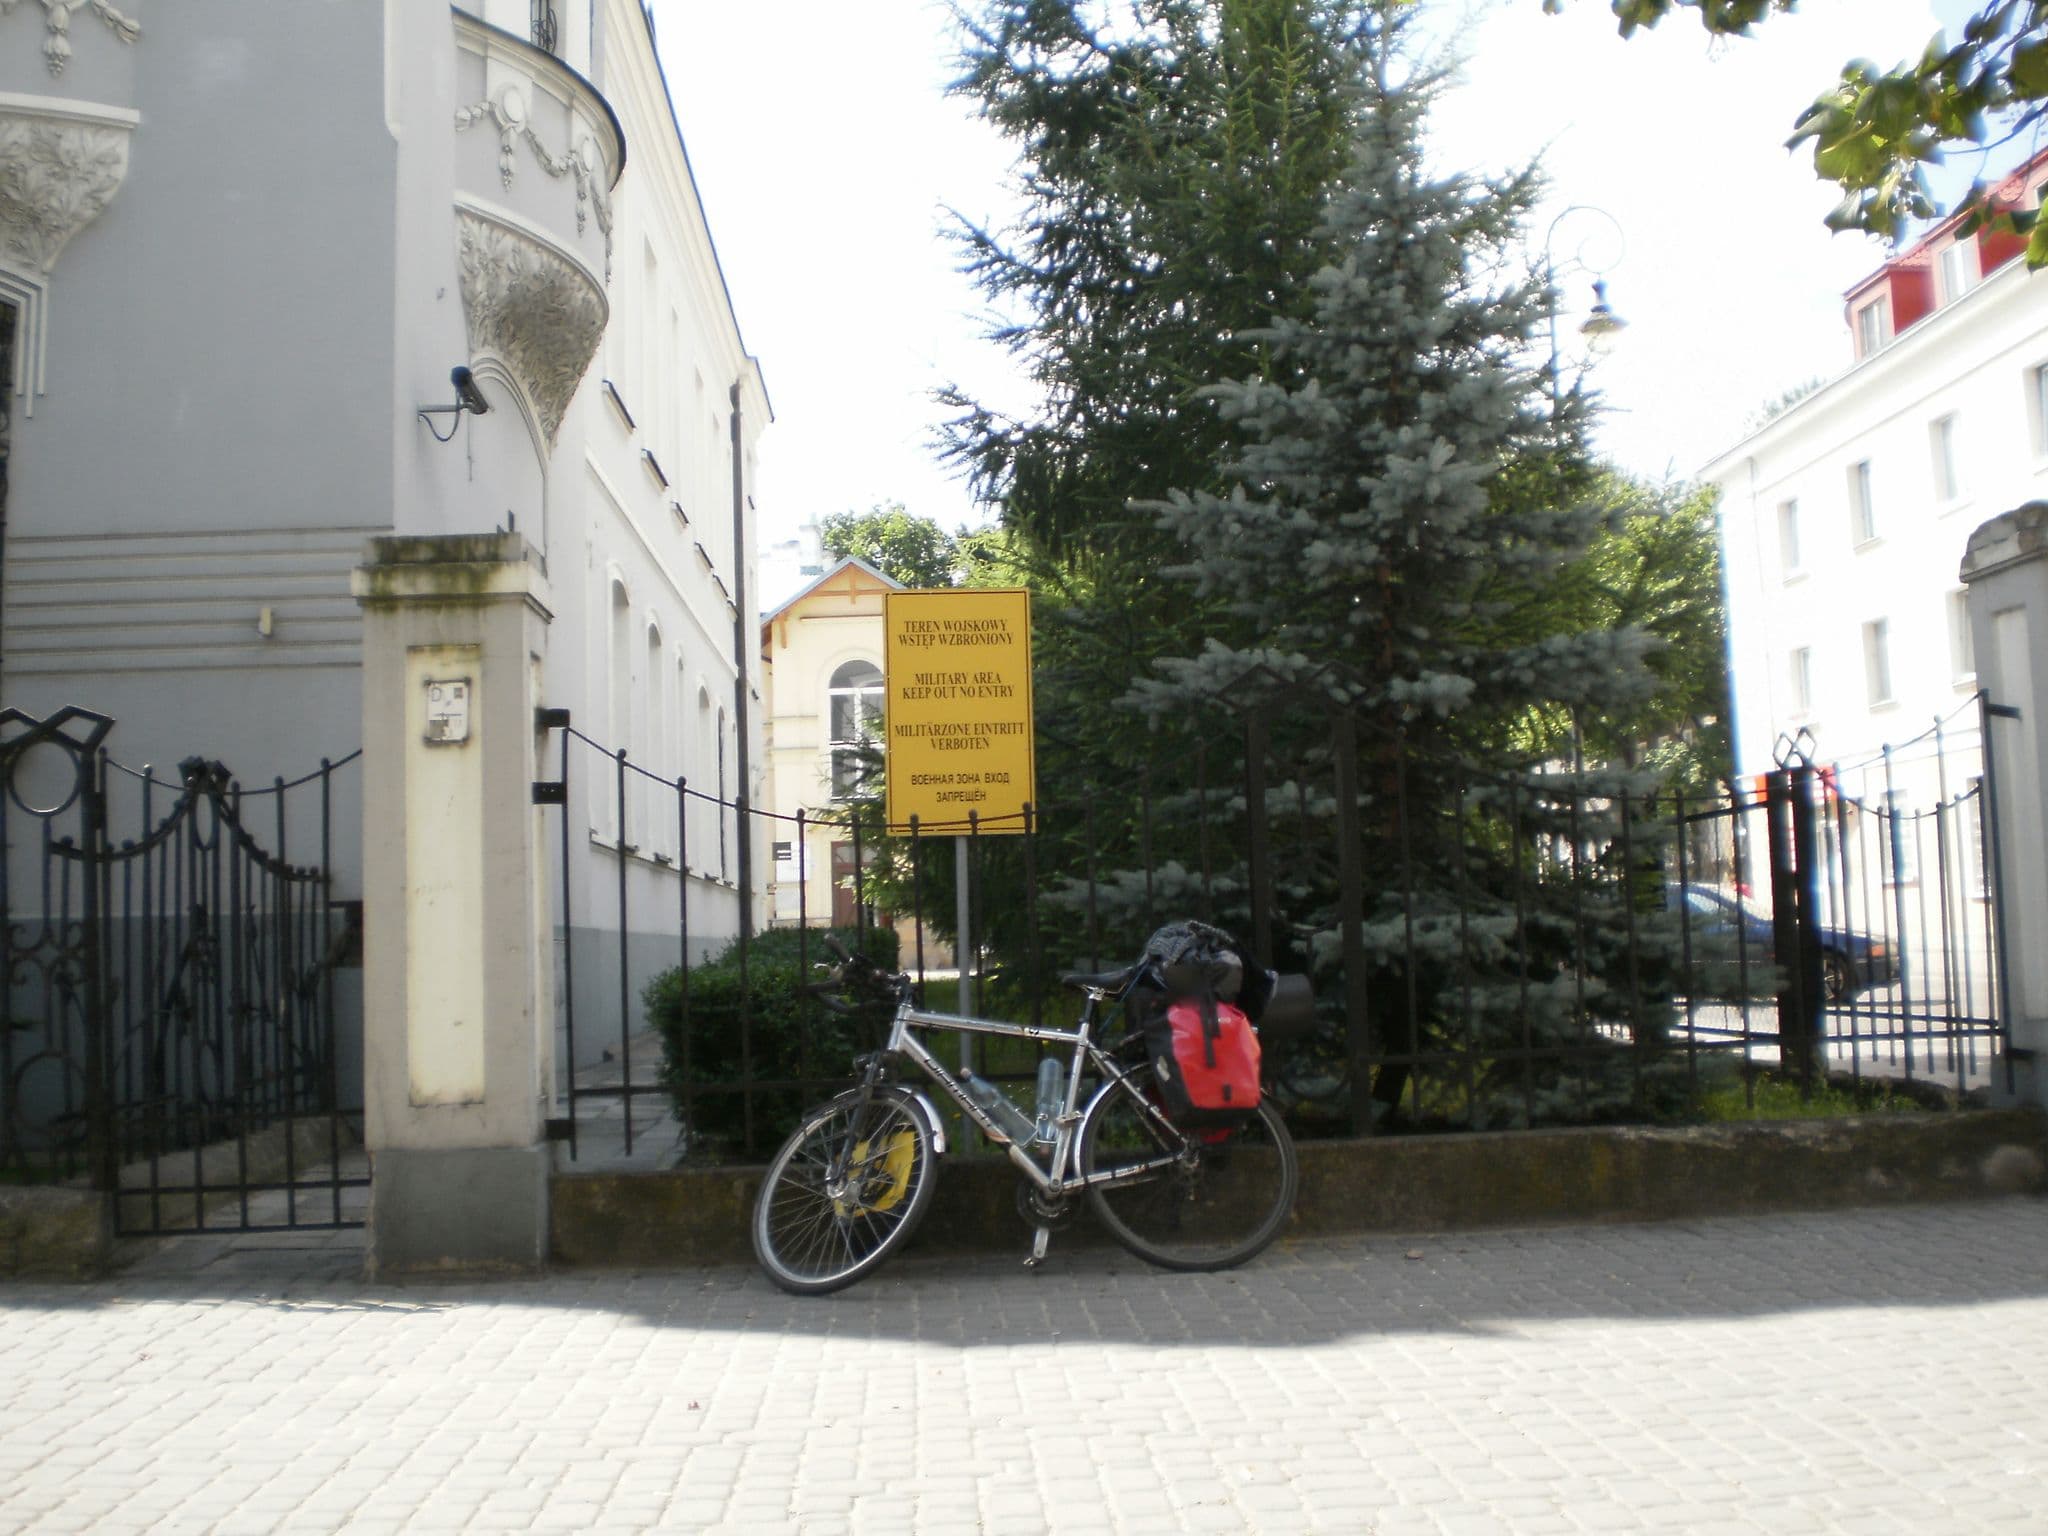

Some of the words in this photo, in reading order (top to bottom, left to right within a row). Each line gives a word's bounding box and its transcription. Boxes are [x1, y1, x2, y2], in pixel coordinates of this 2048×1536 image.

[904, 620, 940, 633] TEREN
[944, 619, 1008, 632] WOJSKOWY
[898, 633, 936, 649] WSTĘP
[939, 632, 1014, 646] WZBRONIONY
[914, 672, 969, 685] MILITARY
[973, 671, 1002, 684] AREA
[903, 686, 932, 699] KEEP
[933, 686, 958, 699] OUT
[959, 685, 976, 698] NO
[979, 685, 1015, 698] ENTRY
[894, 722, 971, 737] MILITÄRZONE
[973, 722, 1025, 735] EINTRITT
[931, 737, 990, 750] VERBOTEN
[911, 774, 954, 785] ВОЕННАЯ
[956, 773, 981, 784] ЗОНА
[984, 772, 1010, 784] ВХОД
